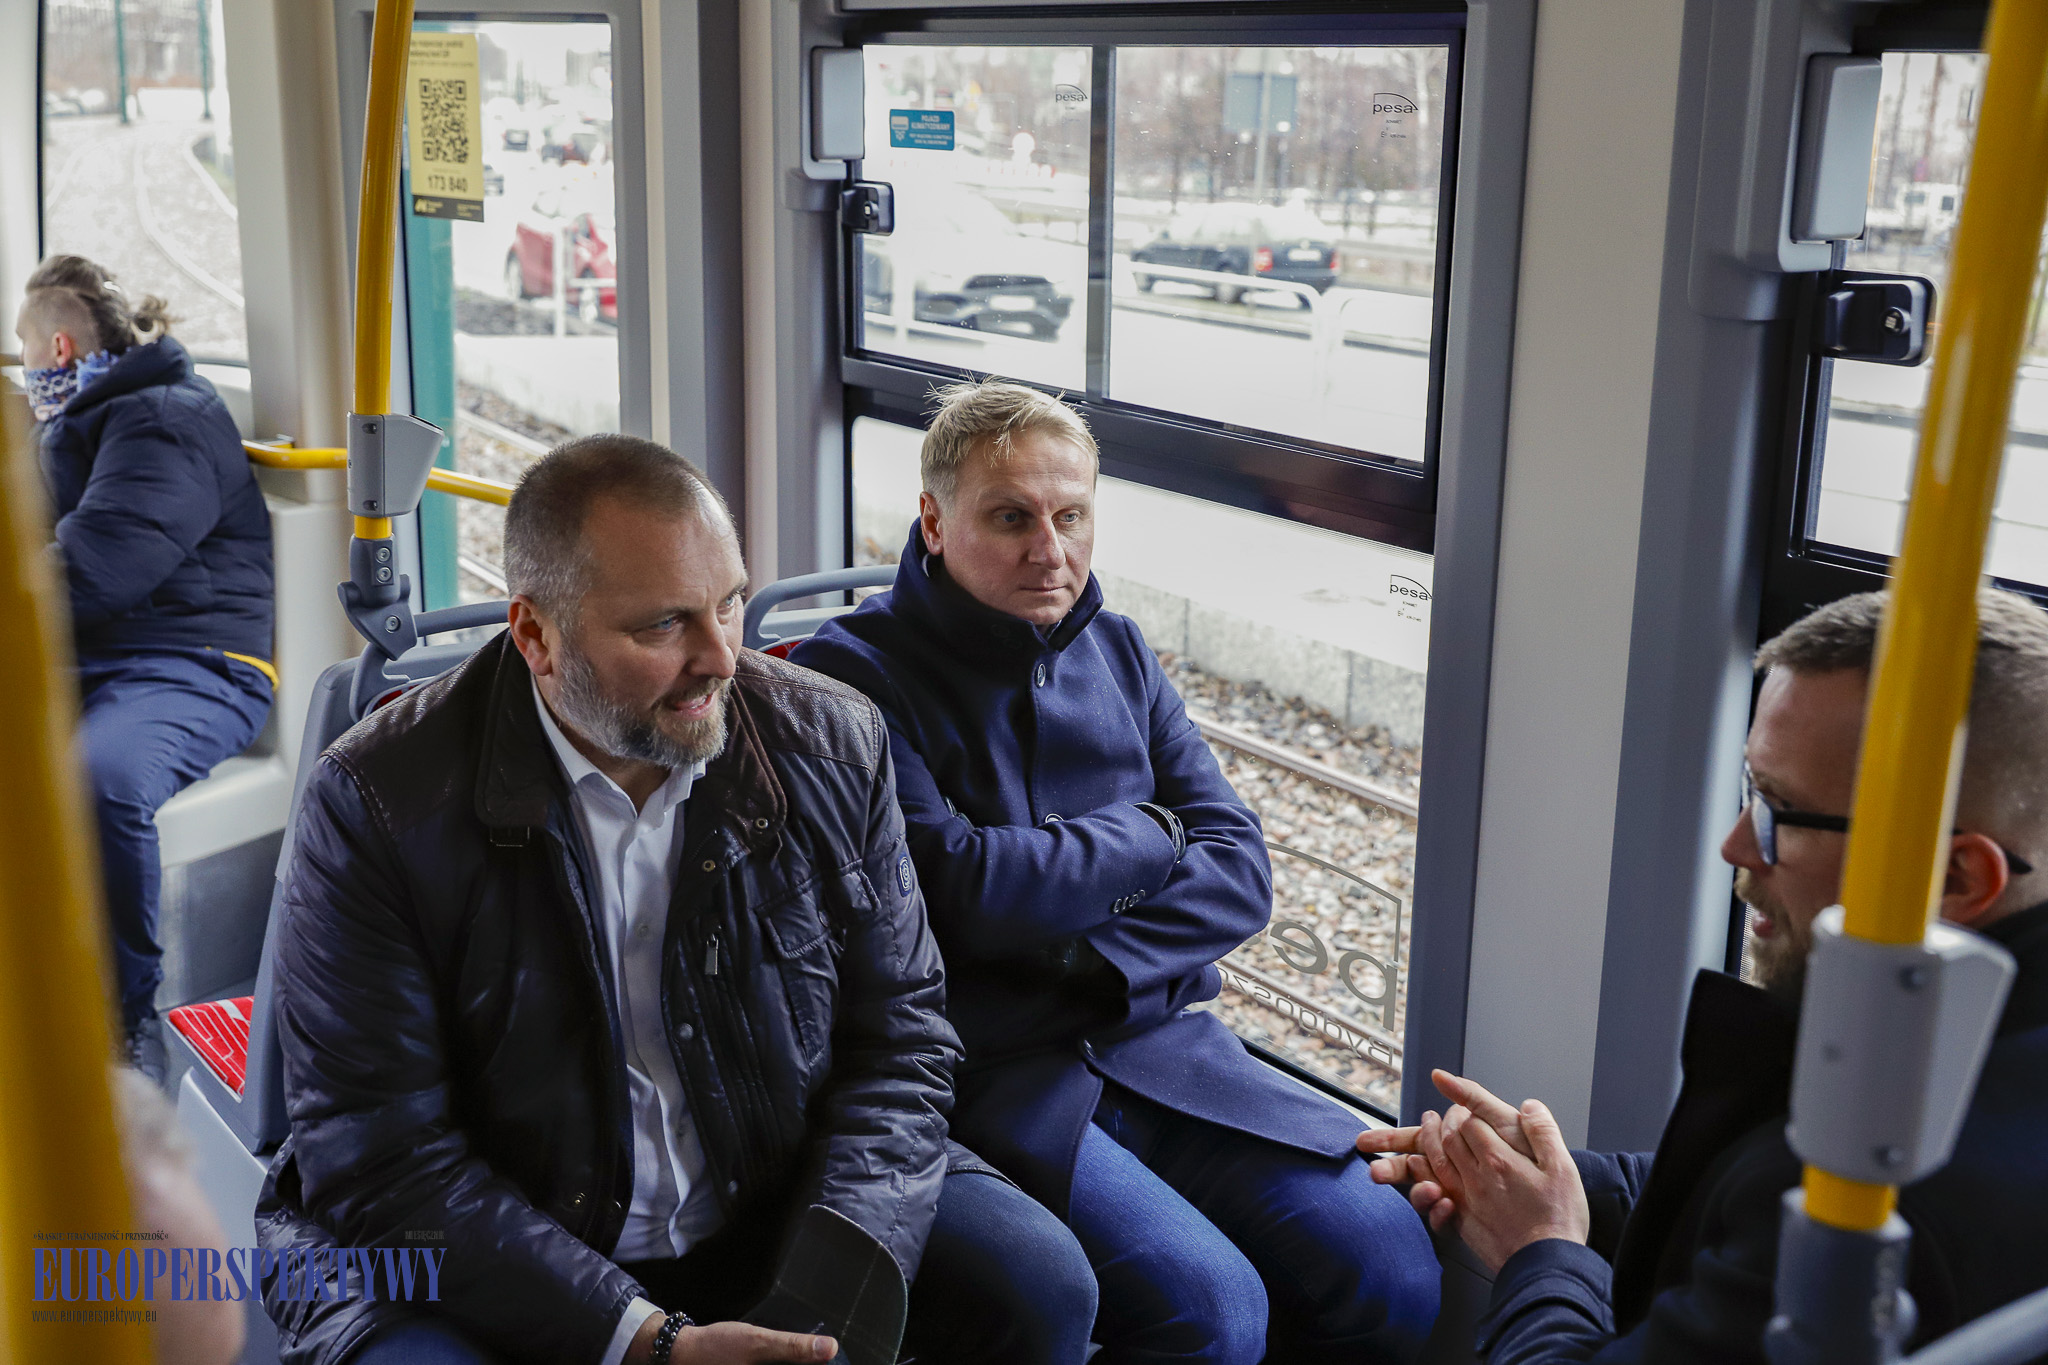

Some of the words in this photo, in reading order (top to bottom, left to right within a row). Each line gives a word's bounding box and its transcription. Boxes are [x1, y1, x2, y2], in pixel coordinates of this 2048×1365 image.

[1055, 93, 1085, 103] pesa
[1372, 103, 1413, 115] pesa
[1389, 584, 1429, 601] pesa
